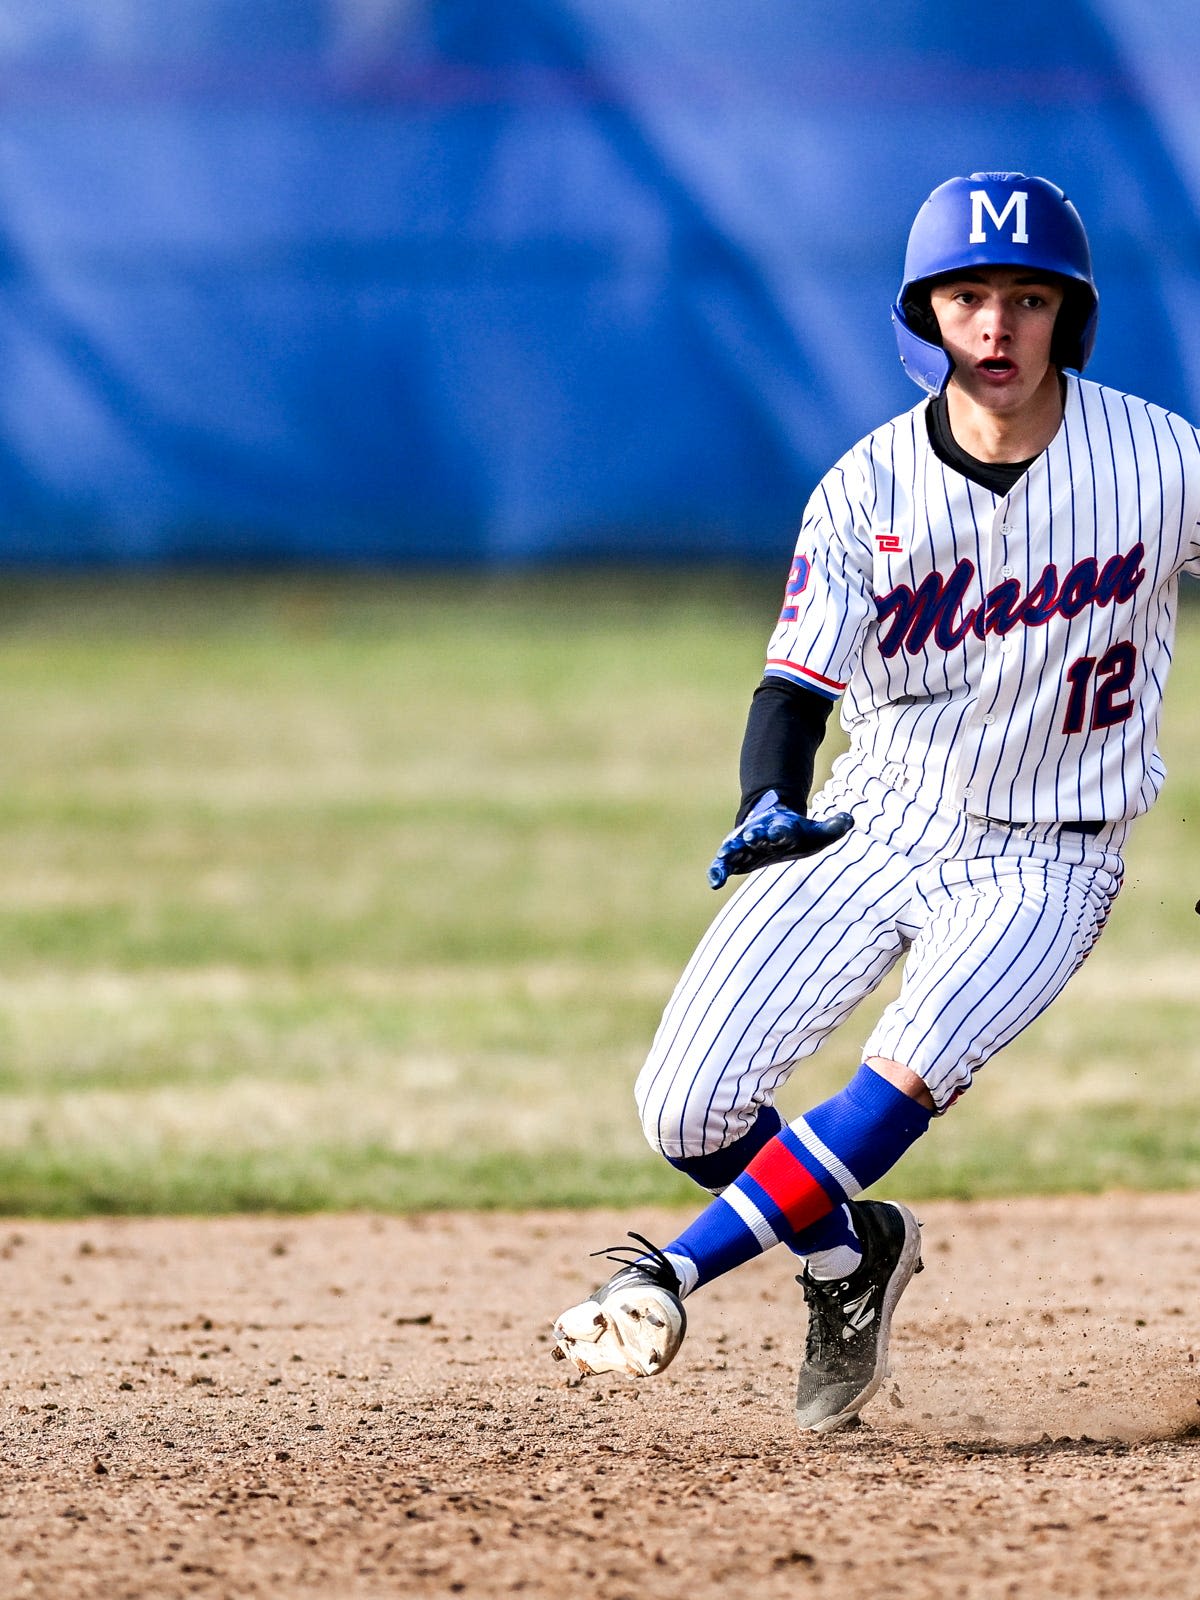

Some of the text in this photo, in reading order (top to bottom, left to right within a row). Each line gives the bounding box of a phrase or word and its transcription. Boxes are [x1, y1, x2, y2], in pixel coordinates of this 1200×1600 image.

[969, 190, 1029, 244] M
[875, 542, 1145, 659] Mason
[1062, 640, 1137, 734] 12
